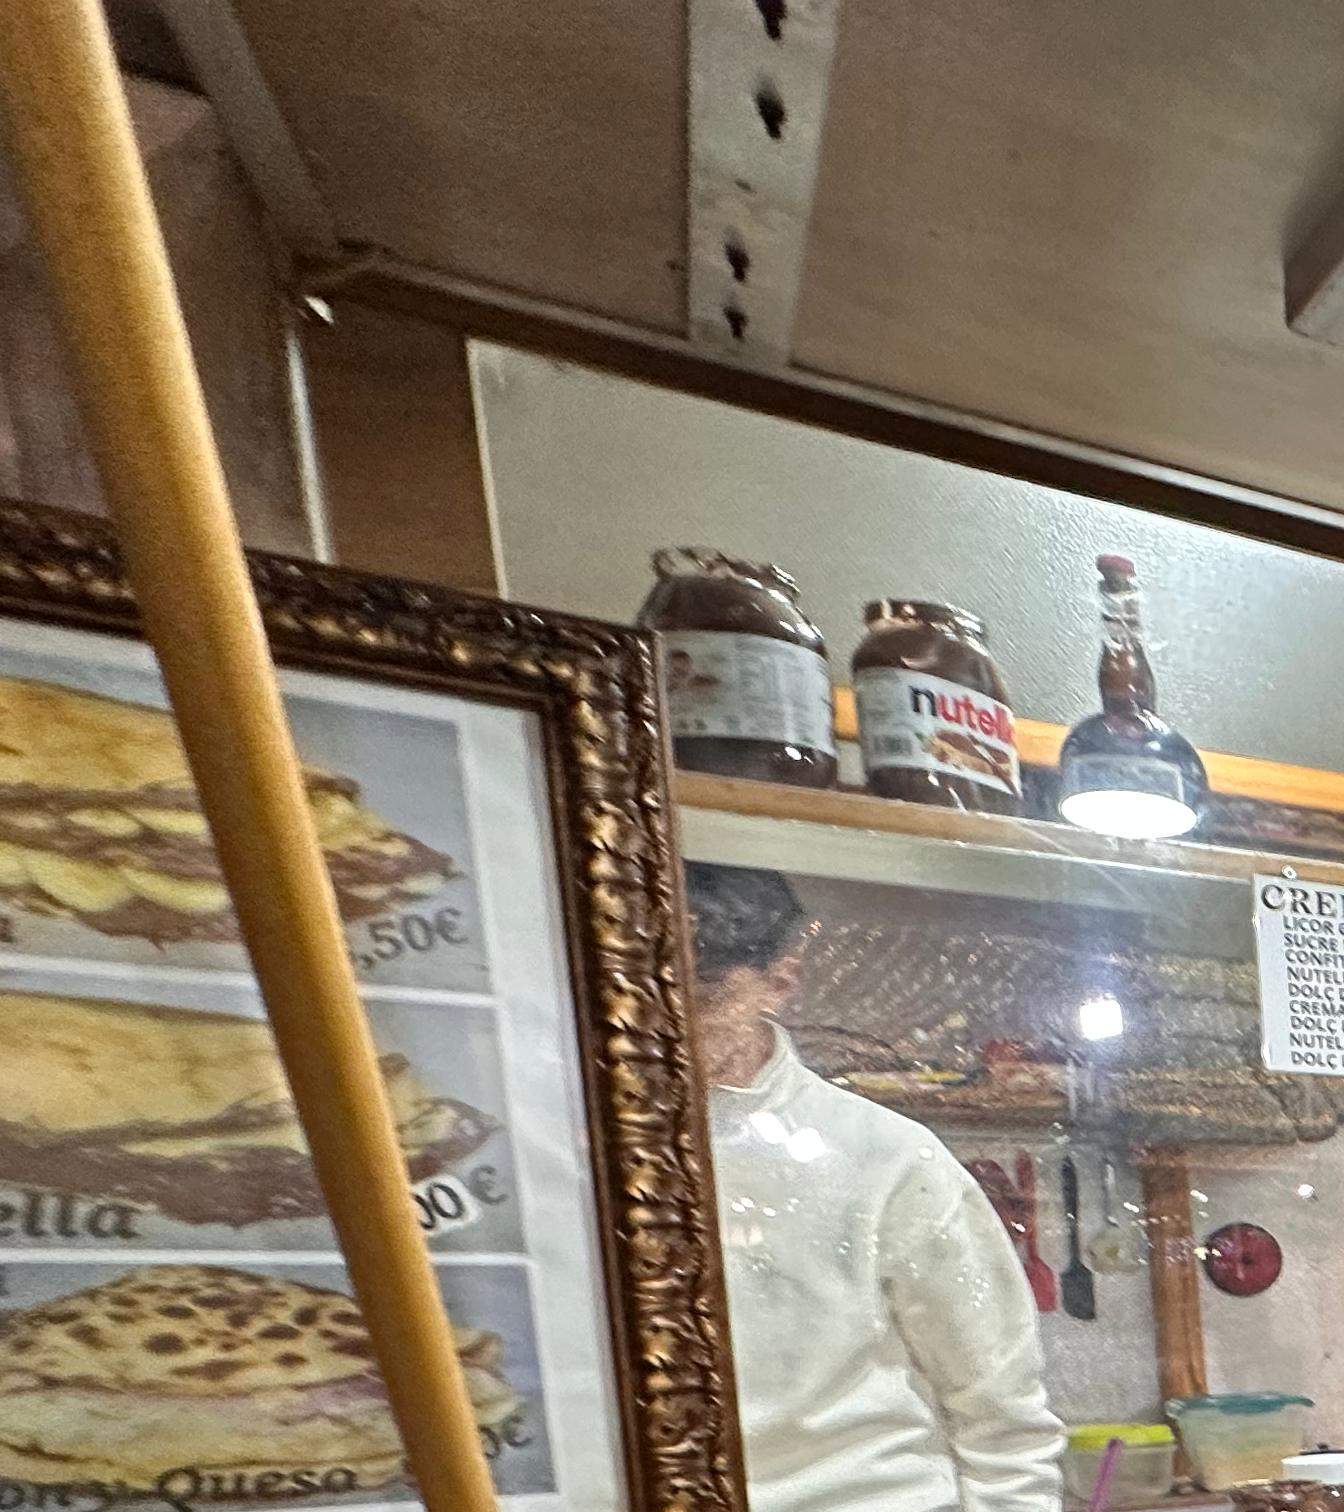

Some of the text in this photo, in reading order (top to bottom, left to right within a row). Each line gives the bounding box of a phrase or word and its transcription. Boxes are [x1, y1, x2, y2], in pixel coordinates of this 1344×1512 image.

[1282, 915, 1335, 935] LICOR
[1283, 933, 1338, 951] SUCRE
[155, 1465, 357, 1512] Queso
